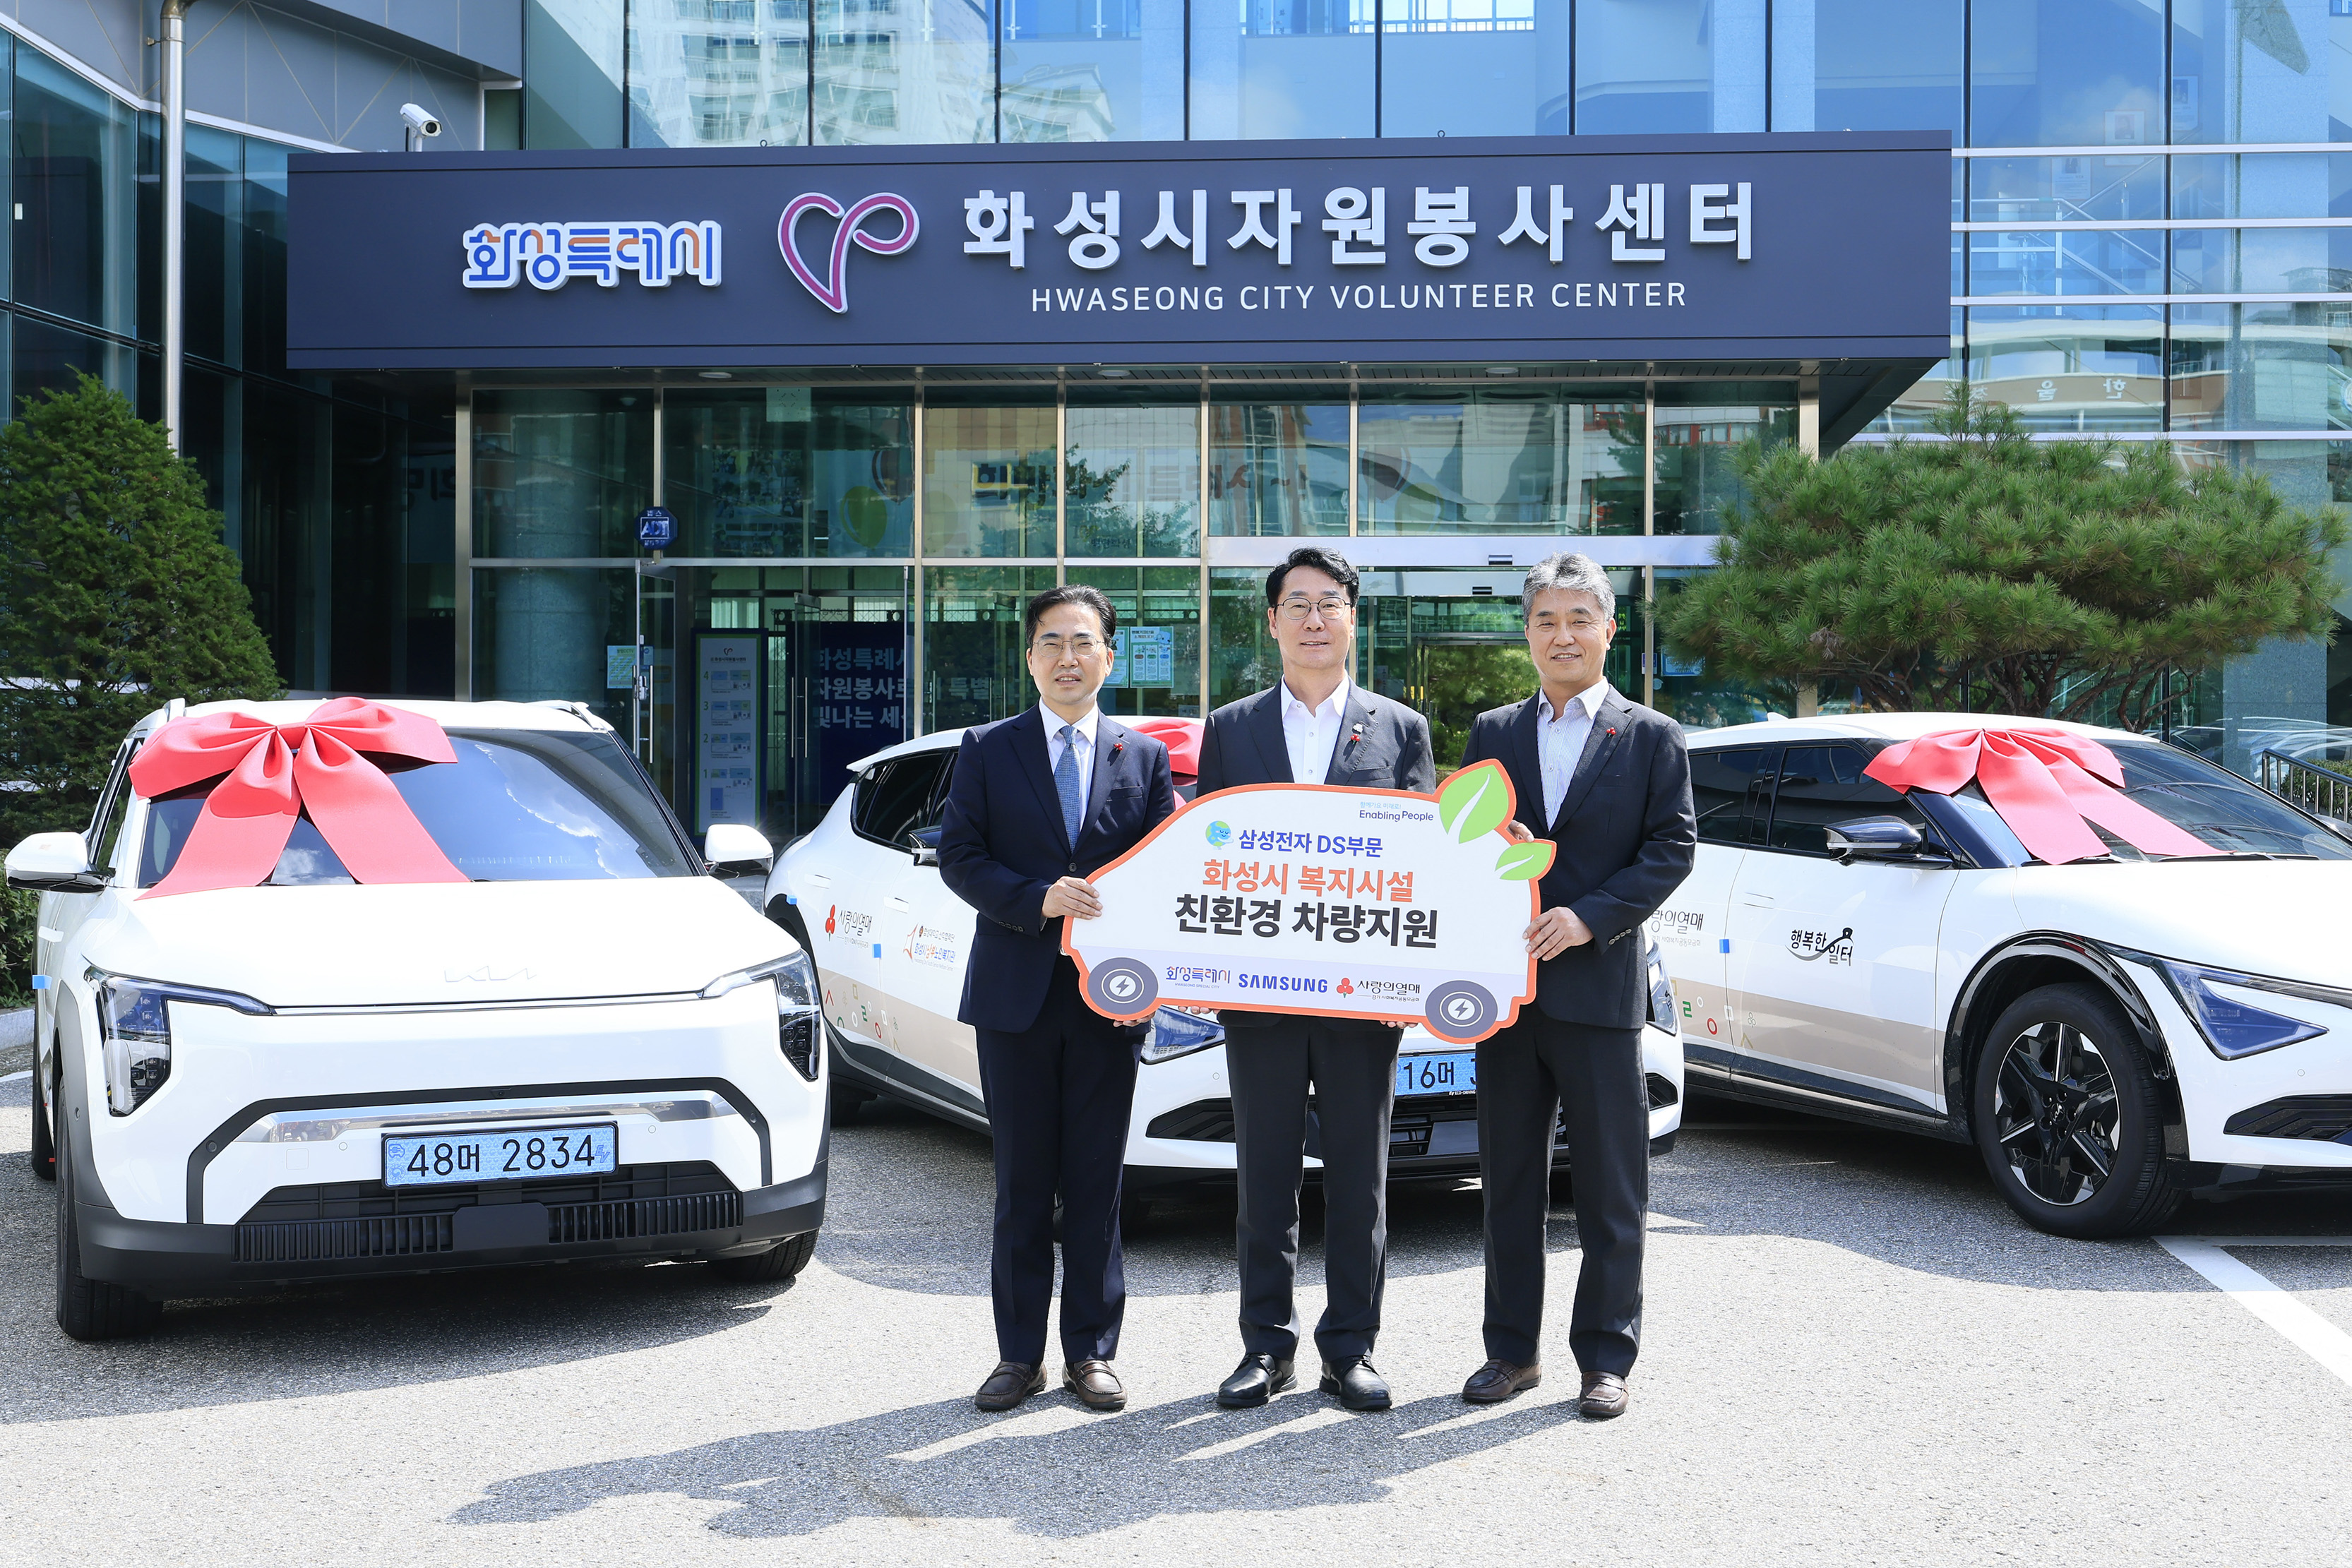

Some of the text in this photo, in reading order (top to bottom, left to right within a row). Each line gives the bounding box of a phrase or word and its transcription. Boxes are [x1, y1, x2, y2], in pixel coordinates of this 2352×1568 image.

[963, 182, 1752, 269] 화성시자원봉사센터
[463, 220, 722, 290] 화성특례시
[1032, 282, 1685, 312] HWASEONG CITY VOLUNTEER CENTER
[640, 519, 669, 536] ADT
[1359, 809, 1434, 822] Enabling People
[1239, 830, 1383, 857] 삼성전자 DS부문
[1202, 858, 1413, 902] 화성시 복지시설
[838, 909, 873, 937] 사랑의열매
[1175, 894, 1438, 948] 친환경 차량지원
[1647, 909, 1704, 935] 랑의열매
[1791, 929, 1853, 966] 행복한 일터
[1166, 966, 1231, 984] 화성특례시
[1238, 974, 1328, 993] SAMSUNG
[1356, 980, 1421, 996] 사랑의열매
[1403, 1060, 1455, 1089] 16머
[407, 1134, 595, 1177] 48머 2834
[595, 1144, 610, 1163] EV
